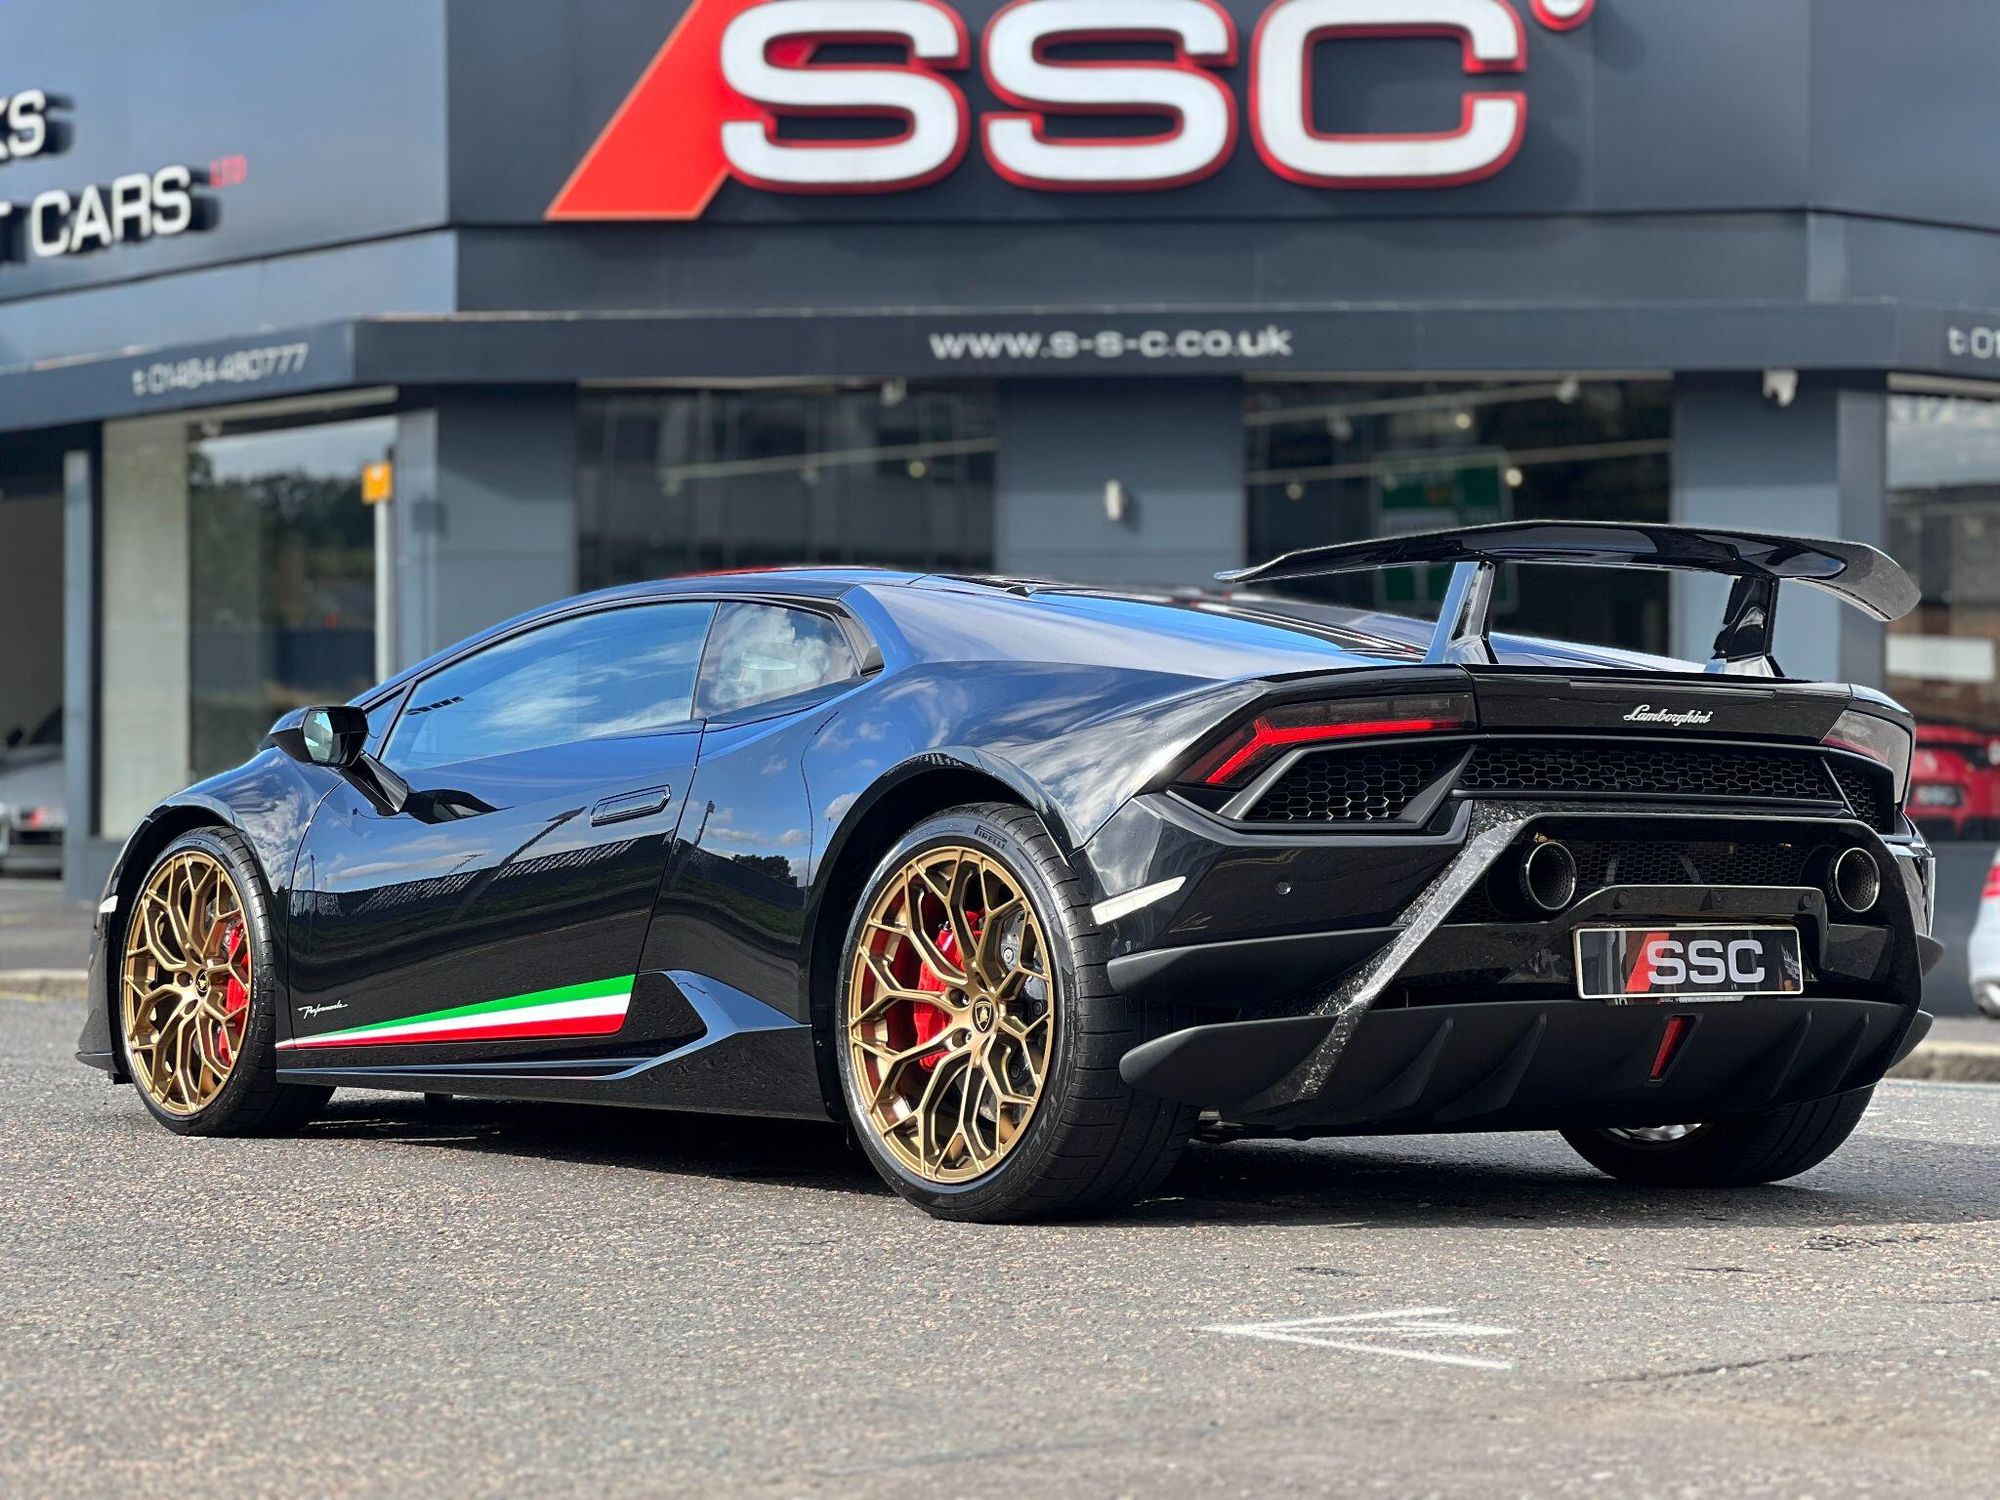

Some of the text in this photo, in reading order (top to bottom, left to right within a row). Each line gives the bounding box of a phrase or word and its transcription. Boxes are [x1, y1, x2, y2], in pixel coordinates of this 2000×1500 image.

[720, 0, 1526, 191] SSC
[0, 88, 46, 158] S
[31, 165, 192, 257] CARS
[929, 324, 1292, 360] www.s-s-c.co.uk
[1623, 704, 1714, 727] Lamborghini
[974, 824, 1008, 850] PIRELLI
[1647, 940, 1764, 984] SSC
